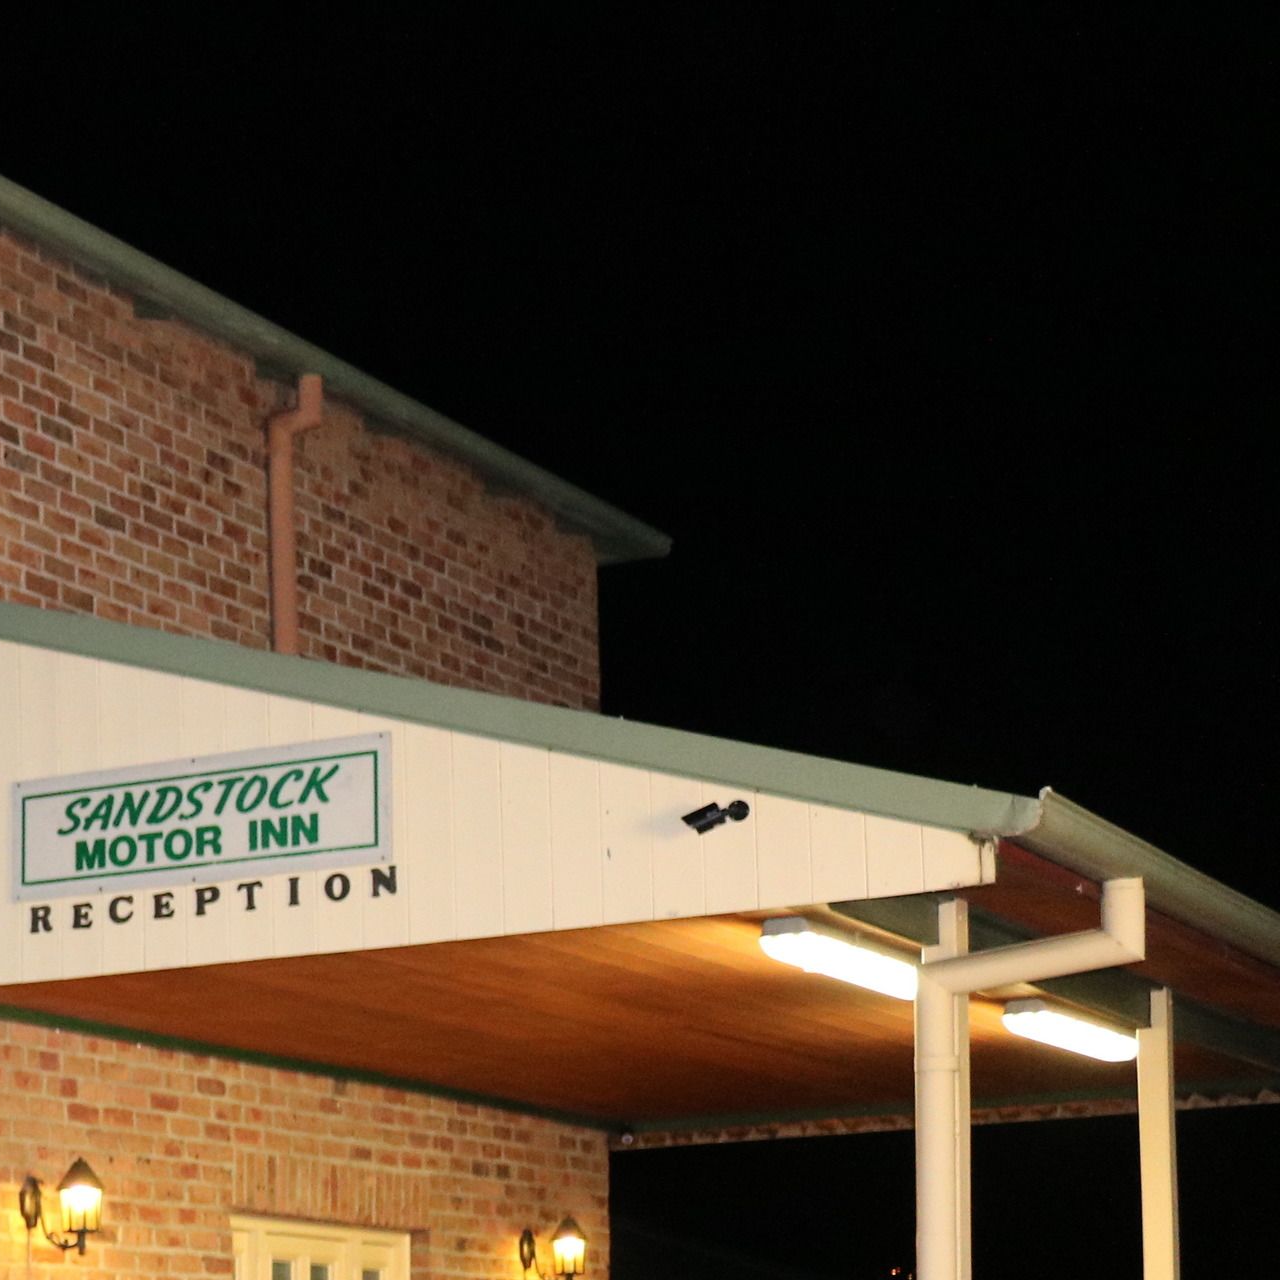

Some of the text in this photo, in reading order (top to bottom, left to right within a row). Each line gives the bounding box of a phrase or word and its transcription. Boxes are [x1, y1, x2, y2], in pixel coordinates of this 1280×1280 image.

[58, 764, 340, 836] SANDSTOCK
[75, 813, 320, 872] MOTOR INN
[29, 865, 398, 934] RECEPTION
